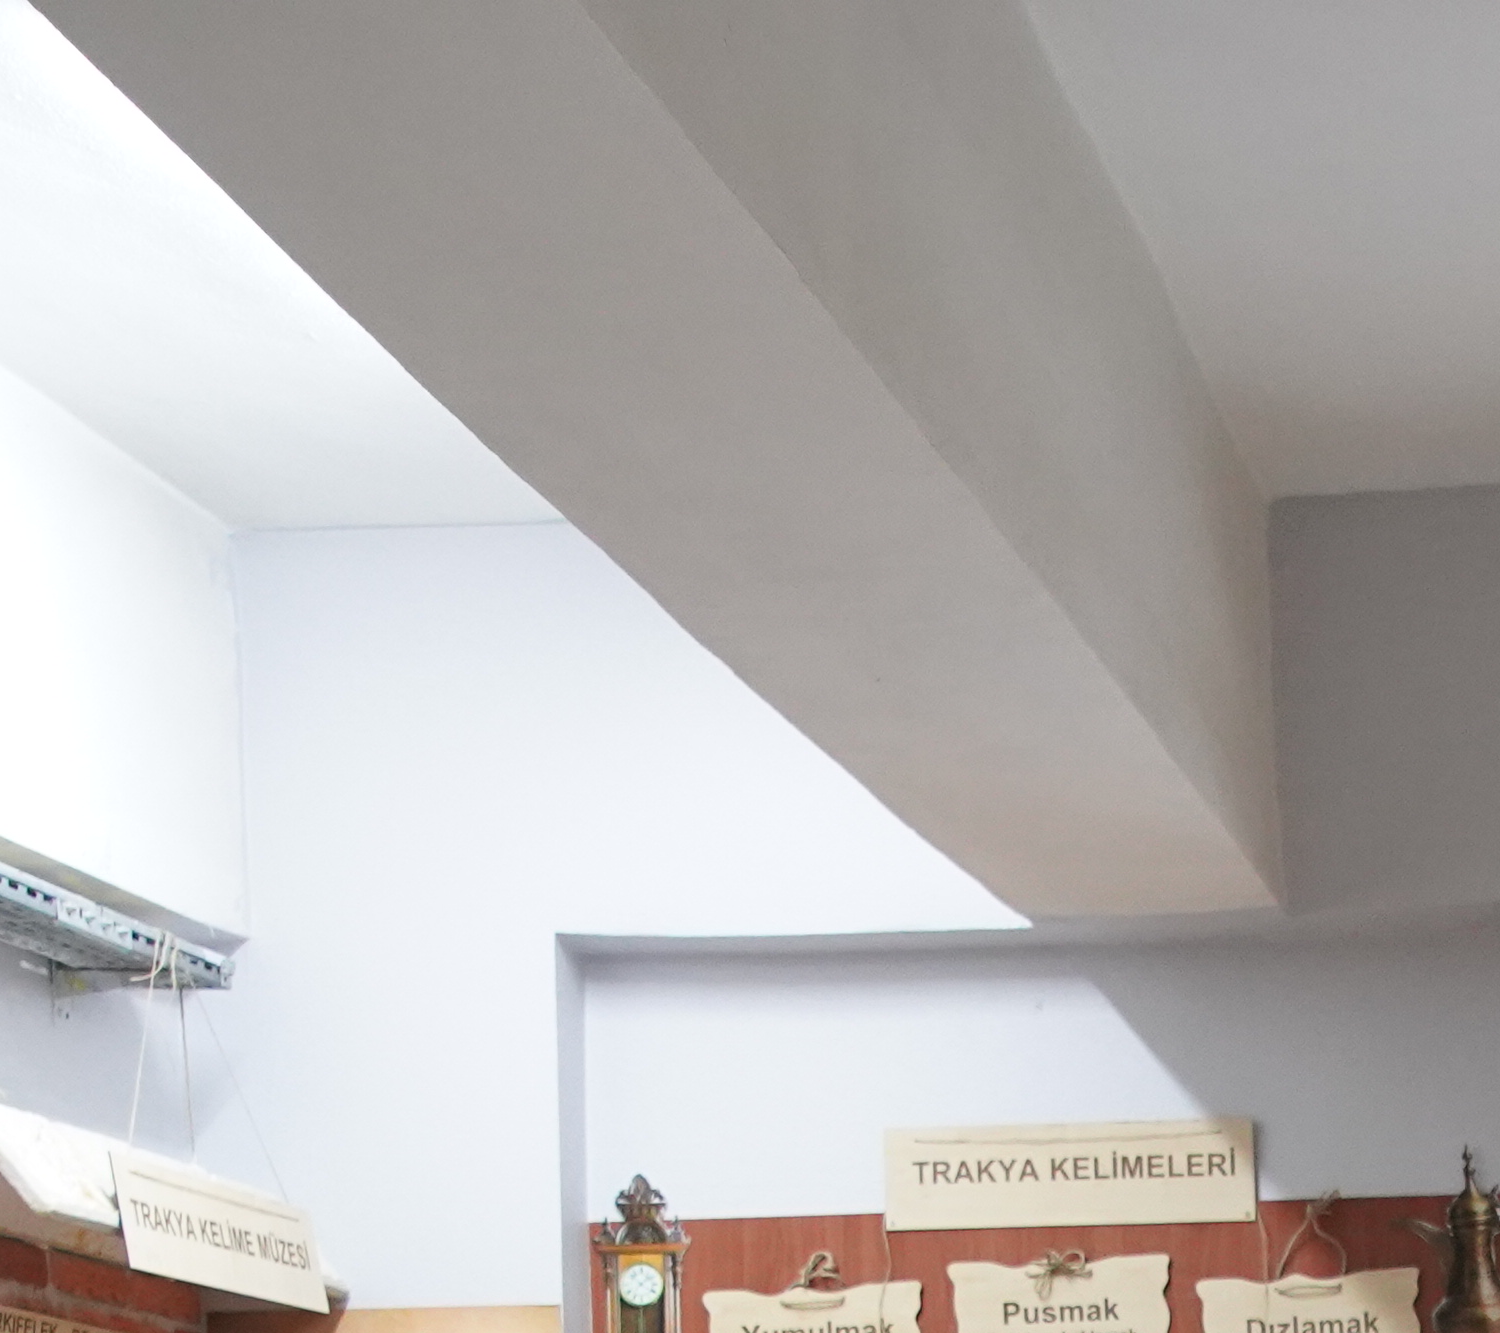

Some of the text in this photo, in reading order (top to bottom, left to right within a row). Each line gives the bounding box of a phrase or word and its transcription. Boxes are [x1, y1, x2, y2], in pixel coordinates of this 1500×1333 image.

[912, 1147, 1238, 1186] TRAKYA KELİMELERİ
[129, 1198, 312, 1272] TRAKYA KELİME MÜZESİ
[1001, 1297, 1121, 1326] Pusmak
